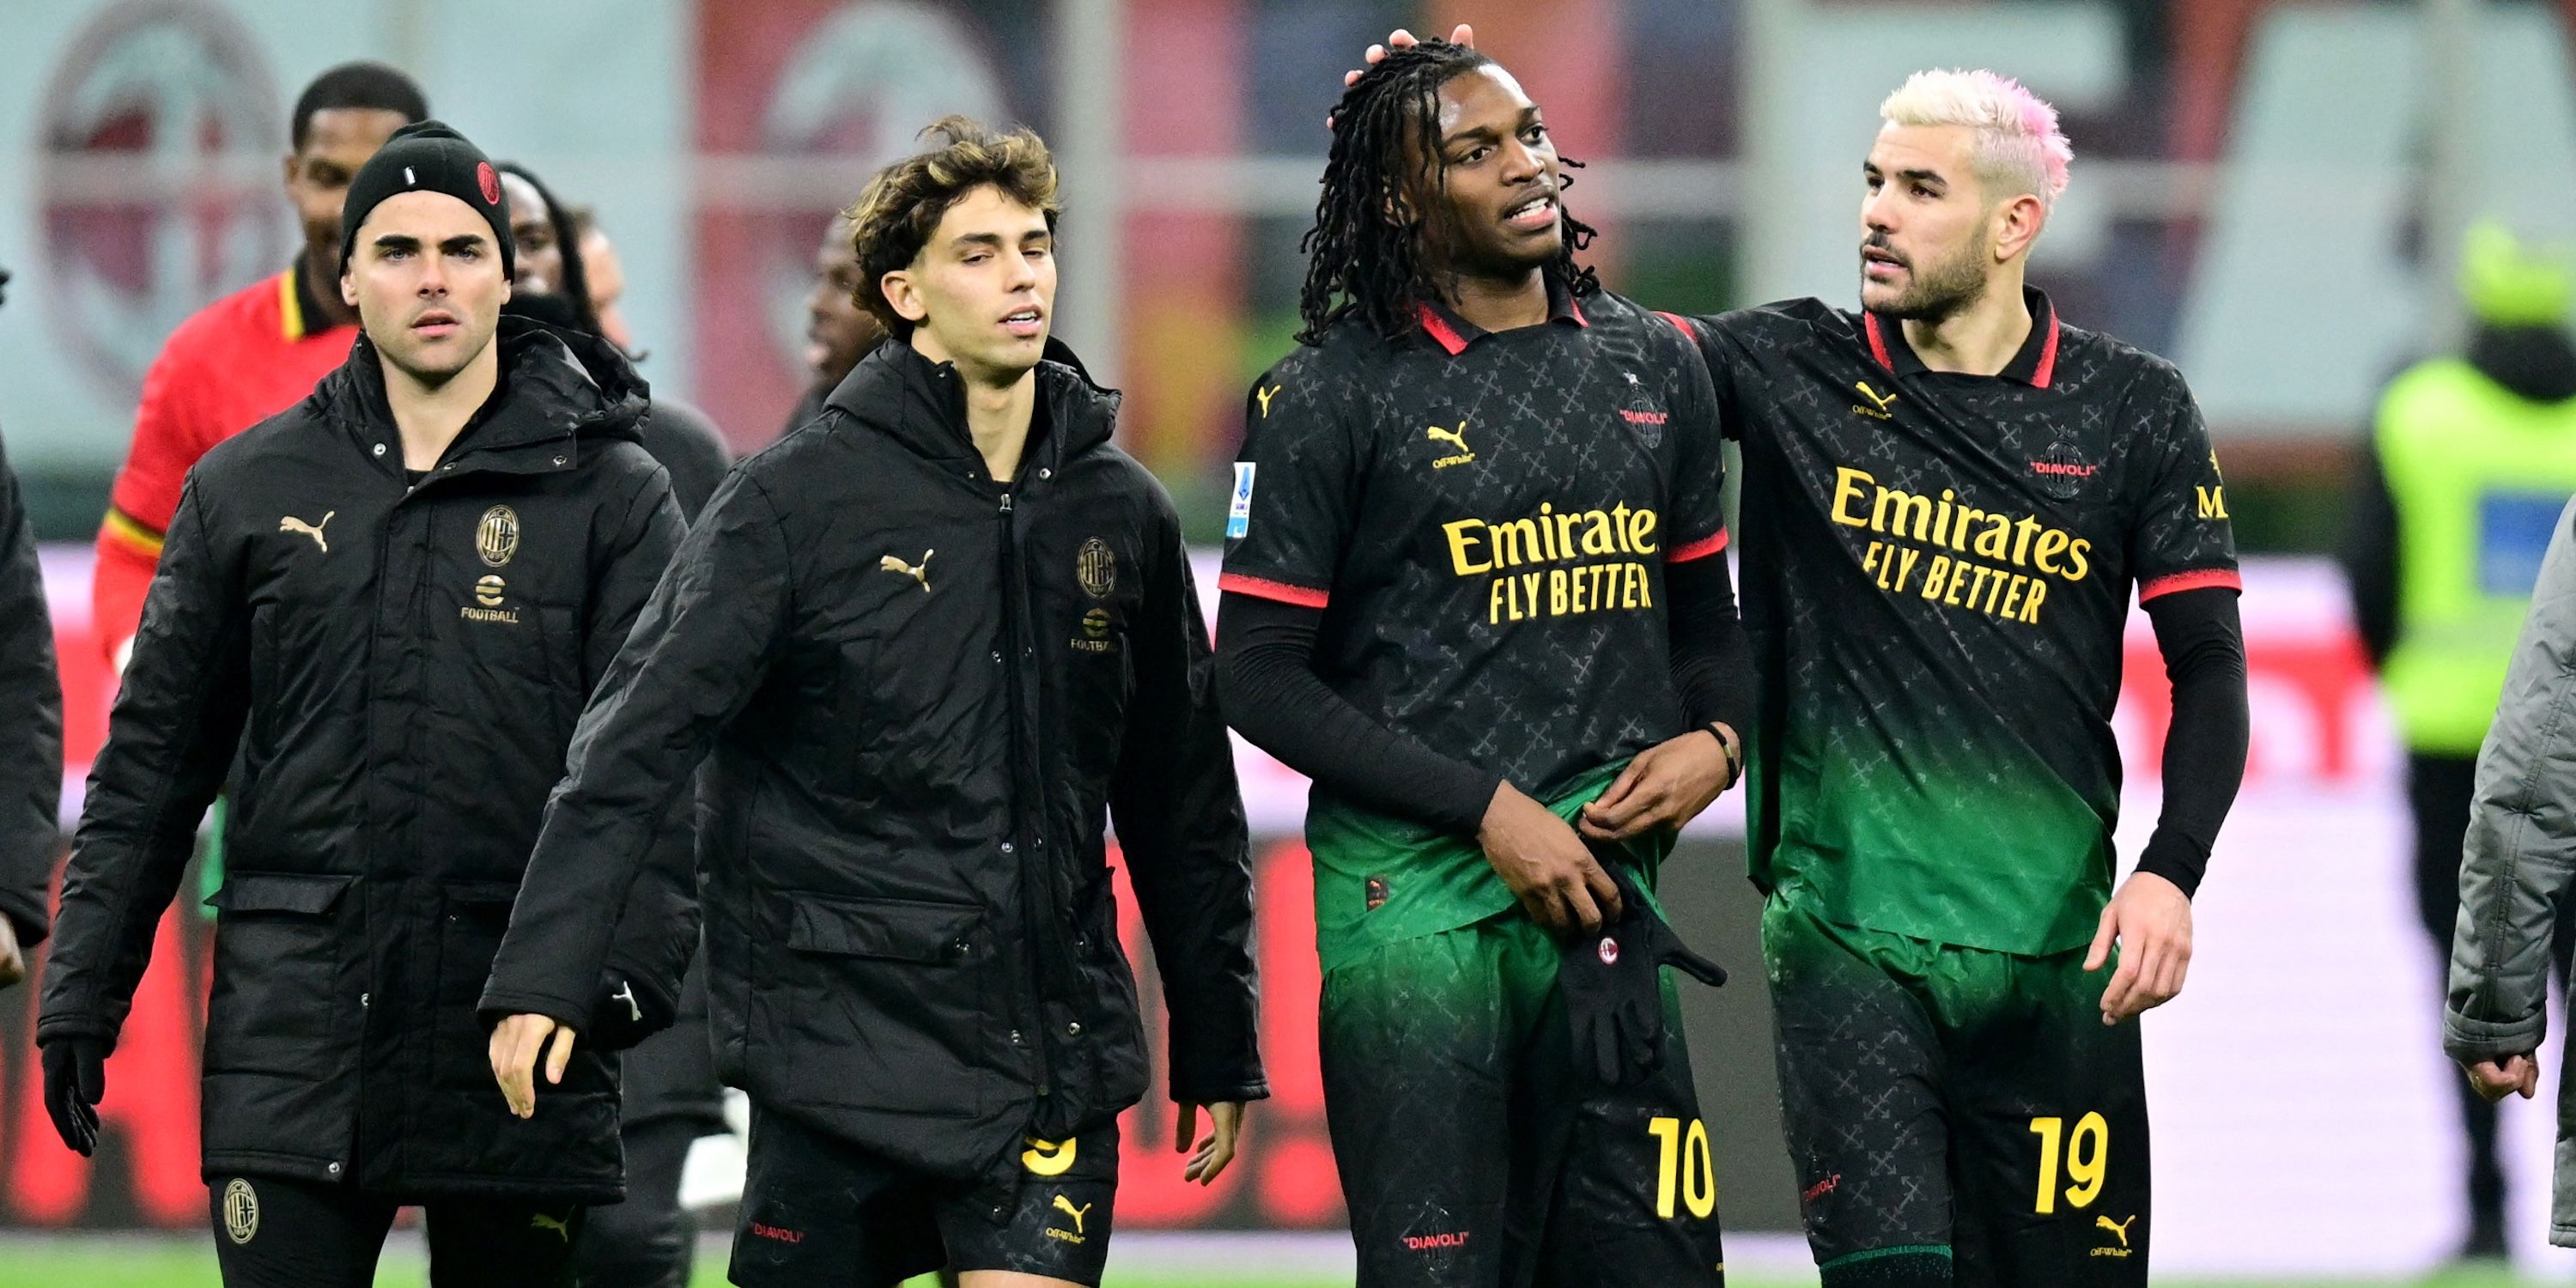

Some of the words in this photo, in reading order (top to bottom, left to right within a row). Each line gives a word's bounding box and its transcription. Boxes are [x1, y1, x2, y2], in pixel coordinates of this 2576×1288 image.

[2030, 461, 2096, 477] "DIAVOLI"
[1442, 499, 1660, 575] Emirate
[1831, 466, 2092, 581] Emirates
[1490, 572, 1540, 625] FLY
[1550, 562, 1652, 617] BETTER
[1862, 541, 1919, 592] FLY
[1921, 555, 2047, 624] BETTER
[1649, 1117, 1715, 1218] 10
[2029, 1111, 2109, 1213] 19
[1402, 1231, 1469, 1249] "DIAVOLI"
